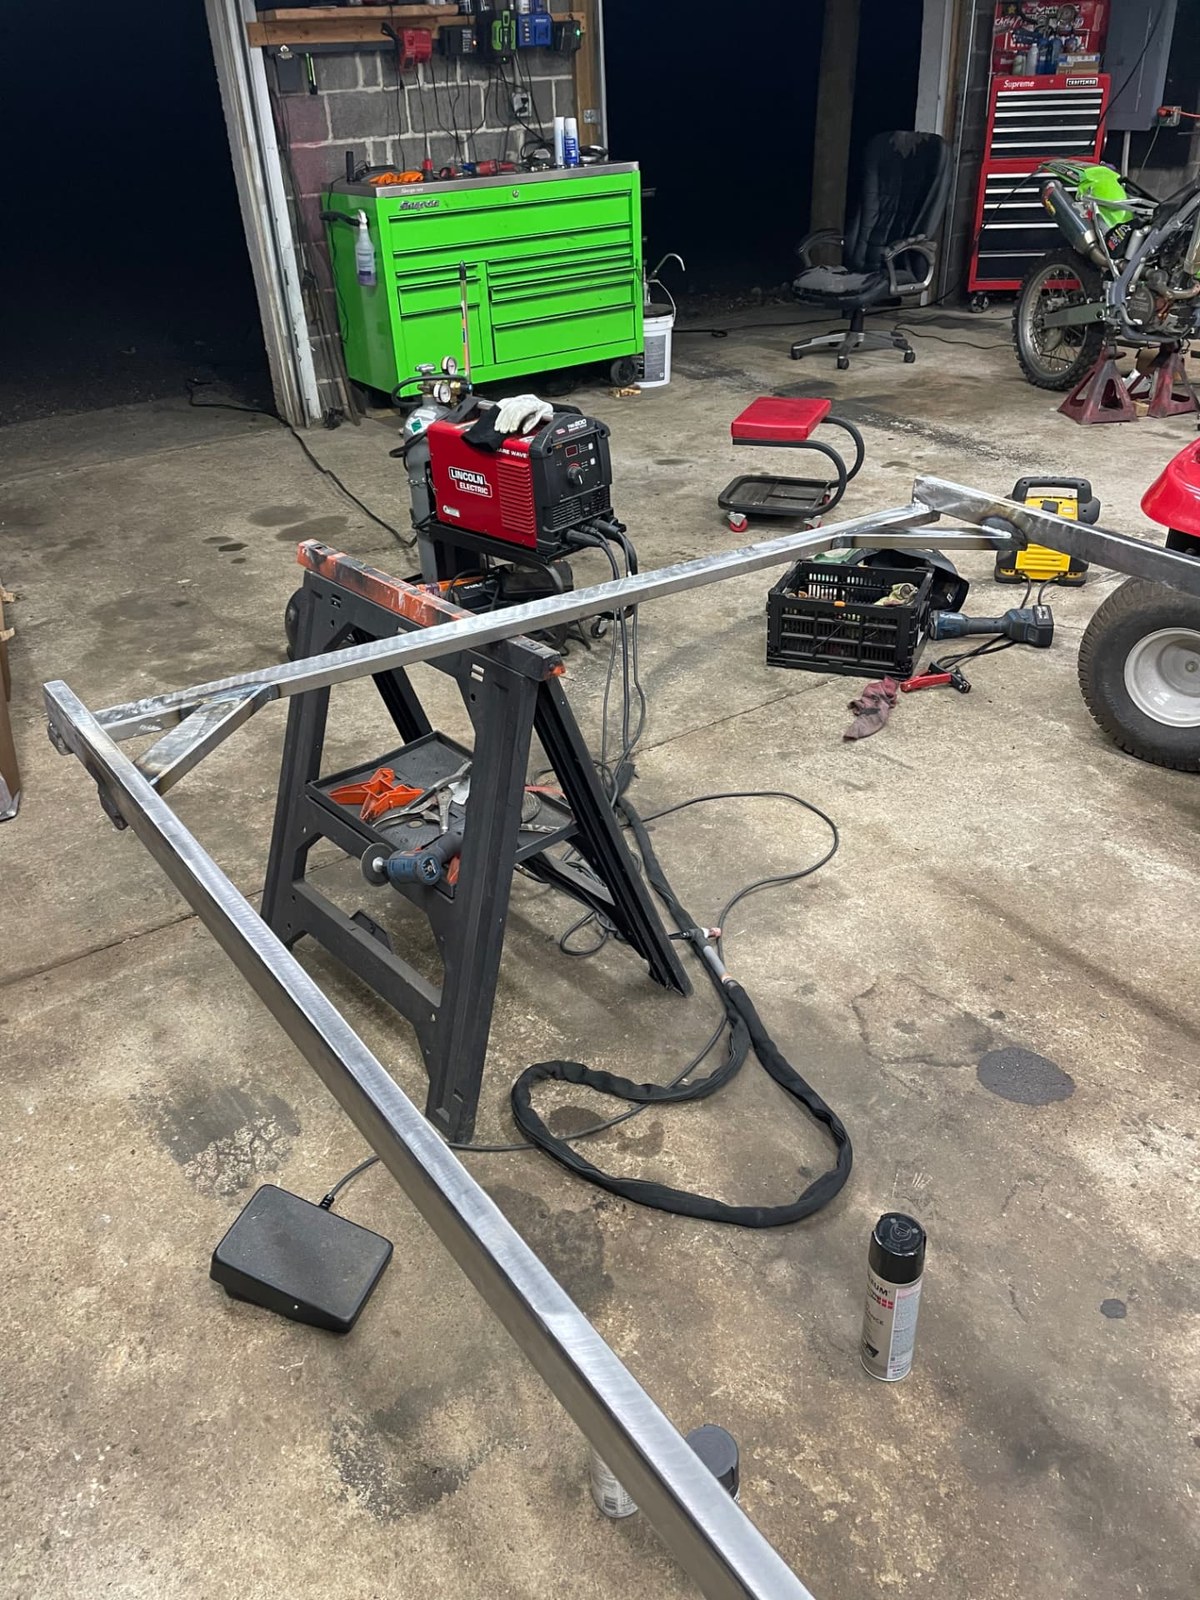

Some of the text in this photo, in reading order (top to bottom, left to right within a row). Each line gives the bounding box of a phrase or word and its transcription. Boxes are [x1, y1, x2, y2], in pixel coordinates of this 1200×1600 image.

[1003, 79, 1035, 89] Supreme
[510, 450, 527, 459] WAVE
[450, 468, 484, 485] LINCOLN
[459, 481, 489, 495] ELECTRIC
